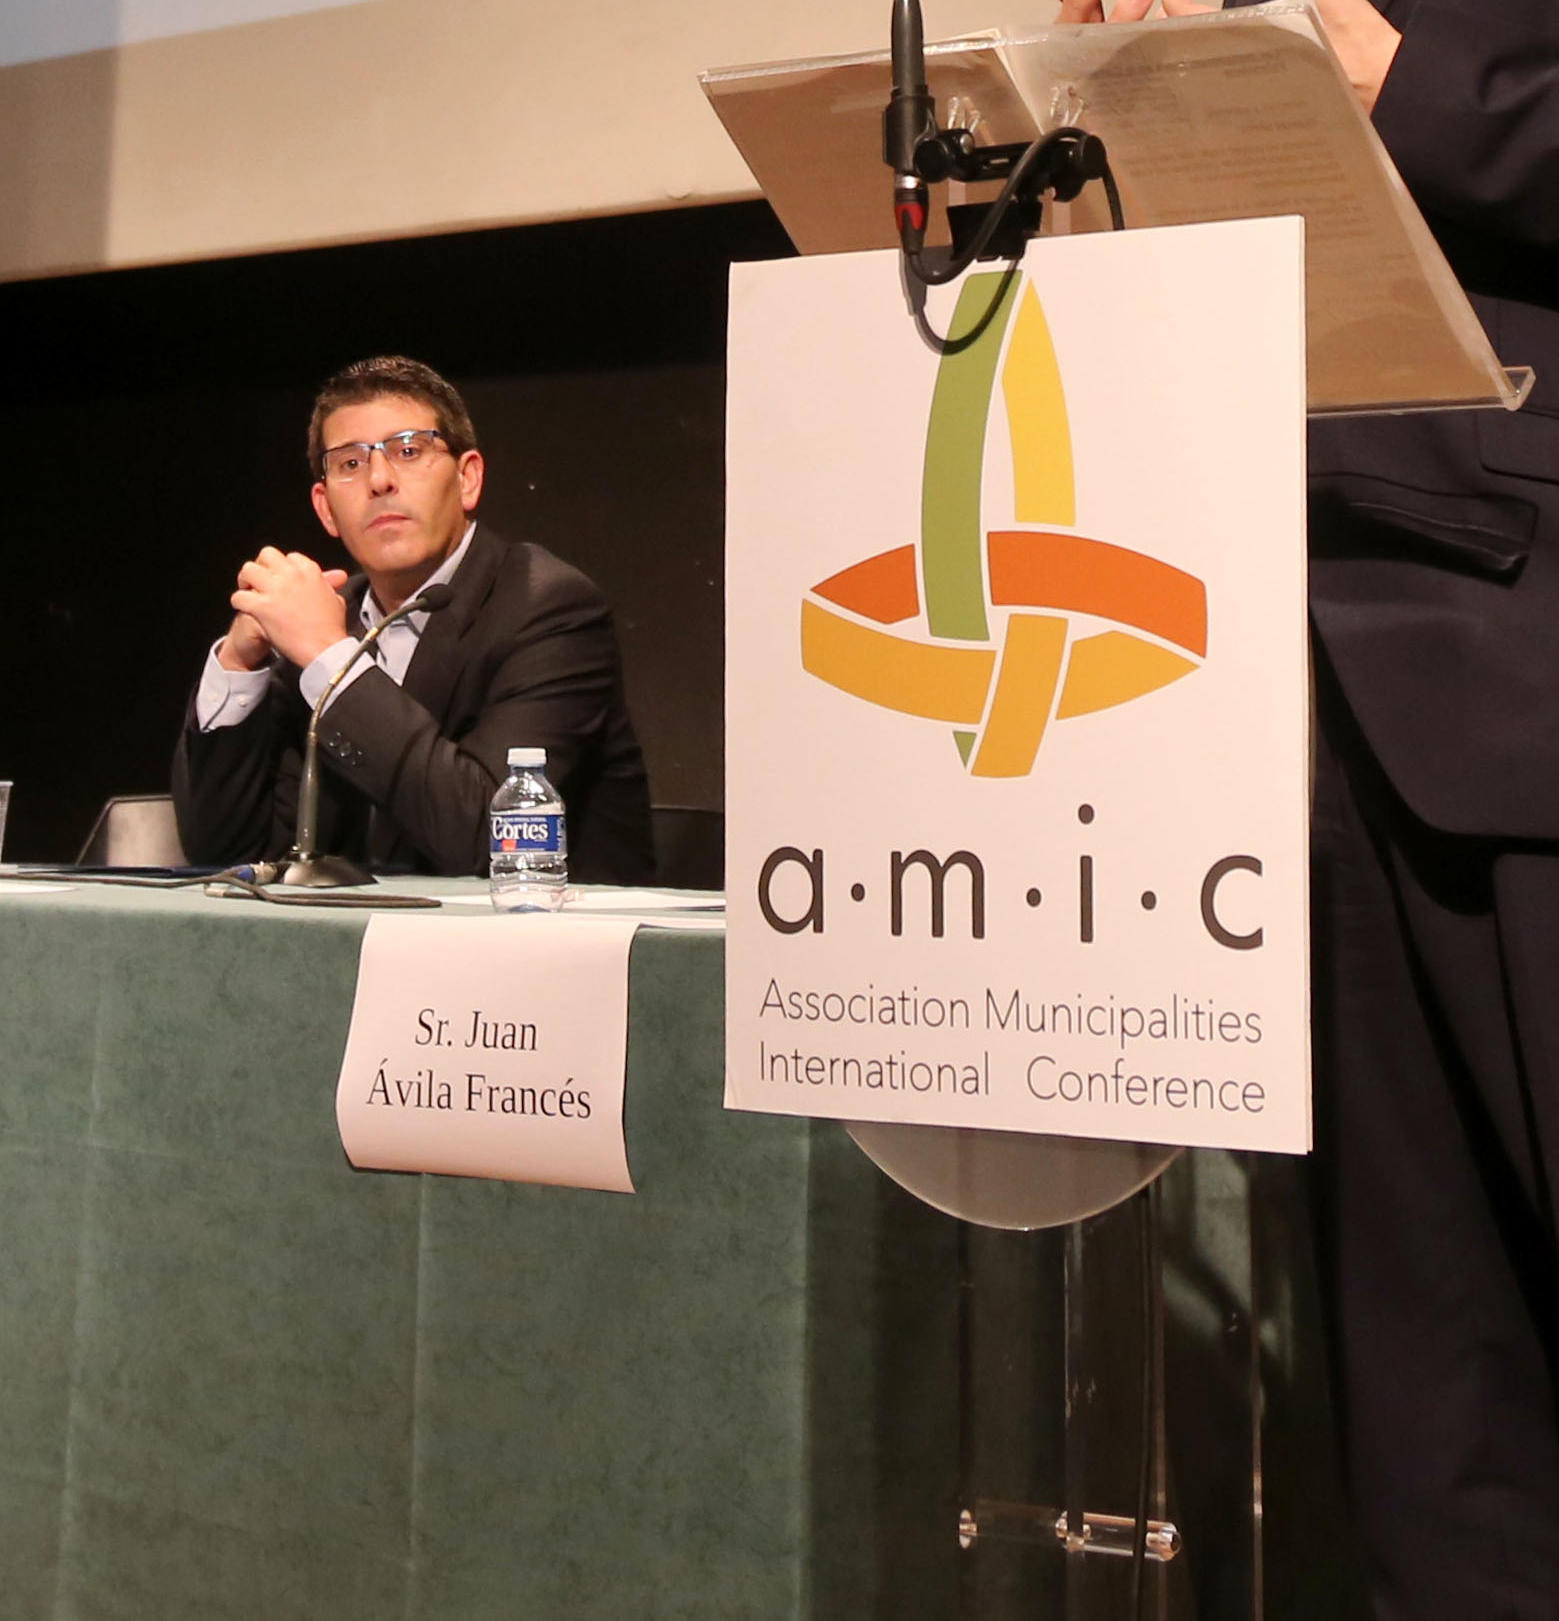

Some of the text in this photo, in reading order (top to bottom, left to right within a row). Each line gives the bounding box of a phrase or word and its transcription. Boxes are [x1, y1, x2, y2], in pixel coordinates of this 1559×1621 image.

[492, 815, 550, 841] Cortes
[414, 1007, 539, 1052] Sr. Juan
[759, 978, 1264, 1050] Association Municipalities
[366, 1058, 593, 1120] Ávila Francés
[759, 1041, 1267, 1114] International Conference
